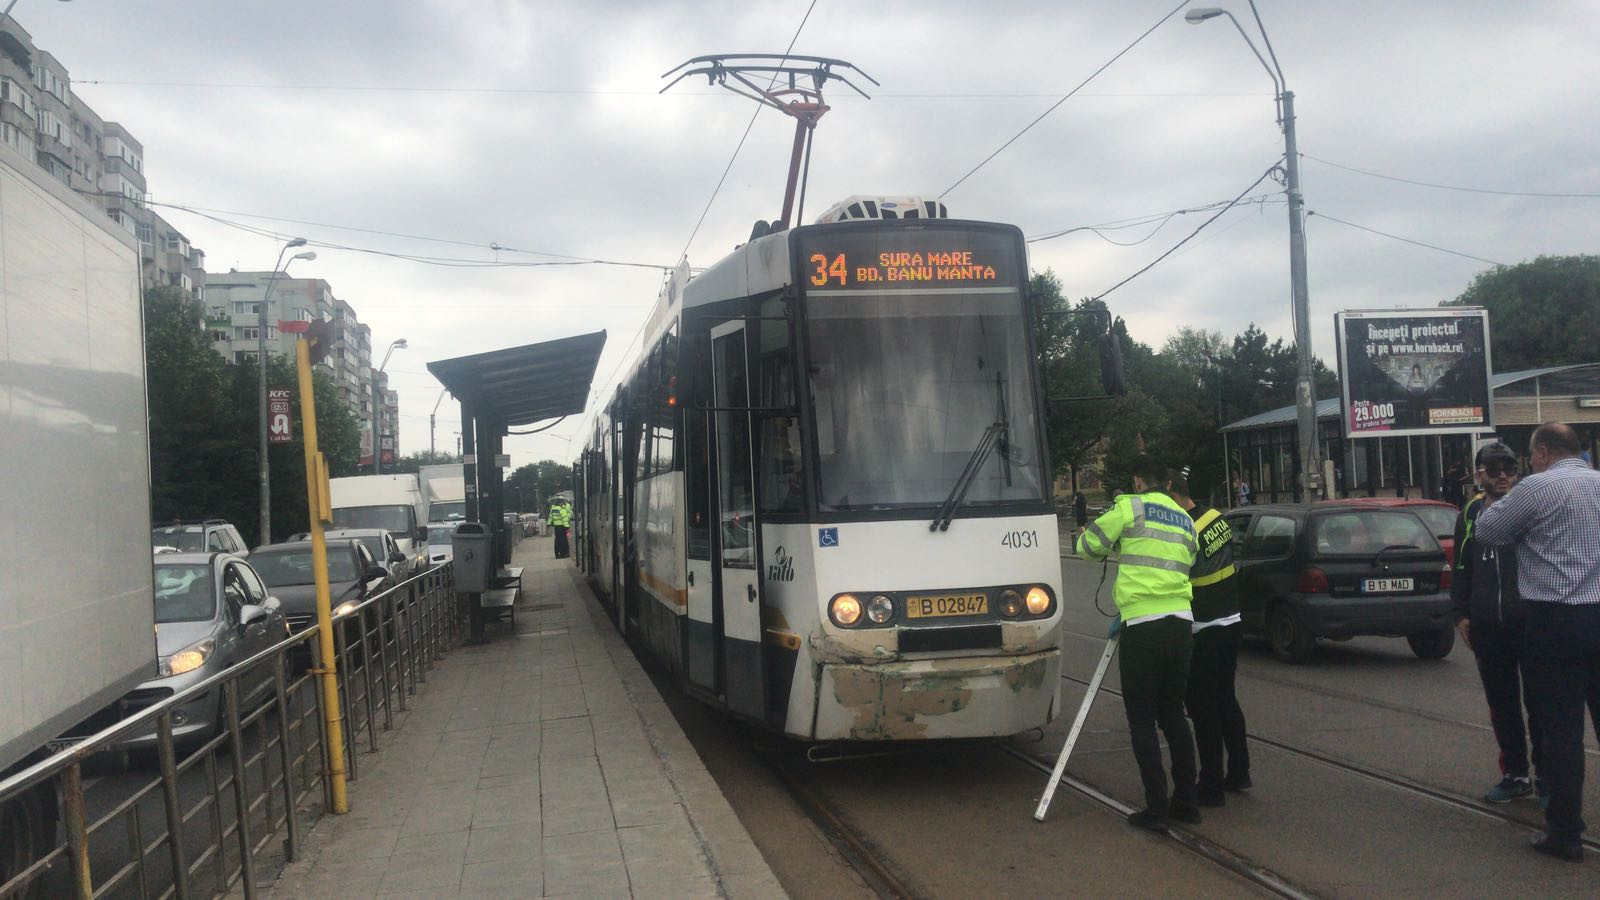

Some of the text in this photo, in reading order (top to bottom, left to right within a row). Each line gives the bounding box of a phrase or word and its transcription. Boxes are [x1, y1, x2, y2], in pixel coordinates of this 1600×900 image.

[880, 252, 972, 267] SURA MARE
[810, 253, 847, 286] 34
[857, 265, 996, 282] BD. BANU MANTA
[1412, 321, 1459, 340] proiectul
[1378, 343, 1389, 356] pe
[1392, 342, 1464, 354] www.hornbach.ro!
[1354, 403, 1394, 421] 29.000
[1430, 408, 1474, 417] HORNBACH
[1001, 529, 1038, 550] 4031
[1203, 519, 1230, 545] POLITIA
[768, 555, 795, 582] ratb
[1368, 580, 1376, 591] B
[1378, 580, 1387, 590] 13
[1391, 579, 1409, 590] MAD
[921, 596, 984, 615] B 02847
